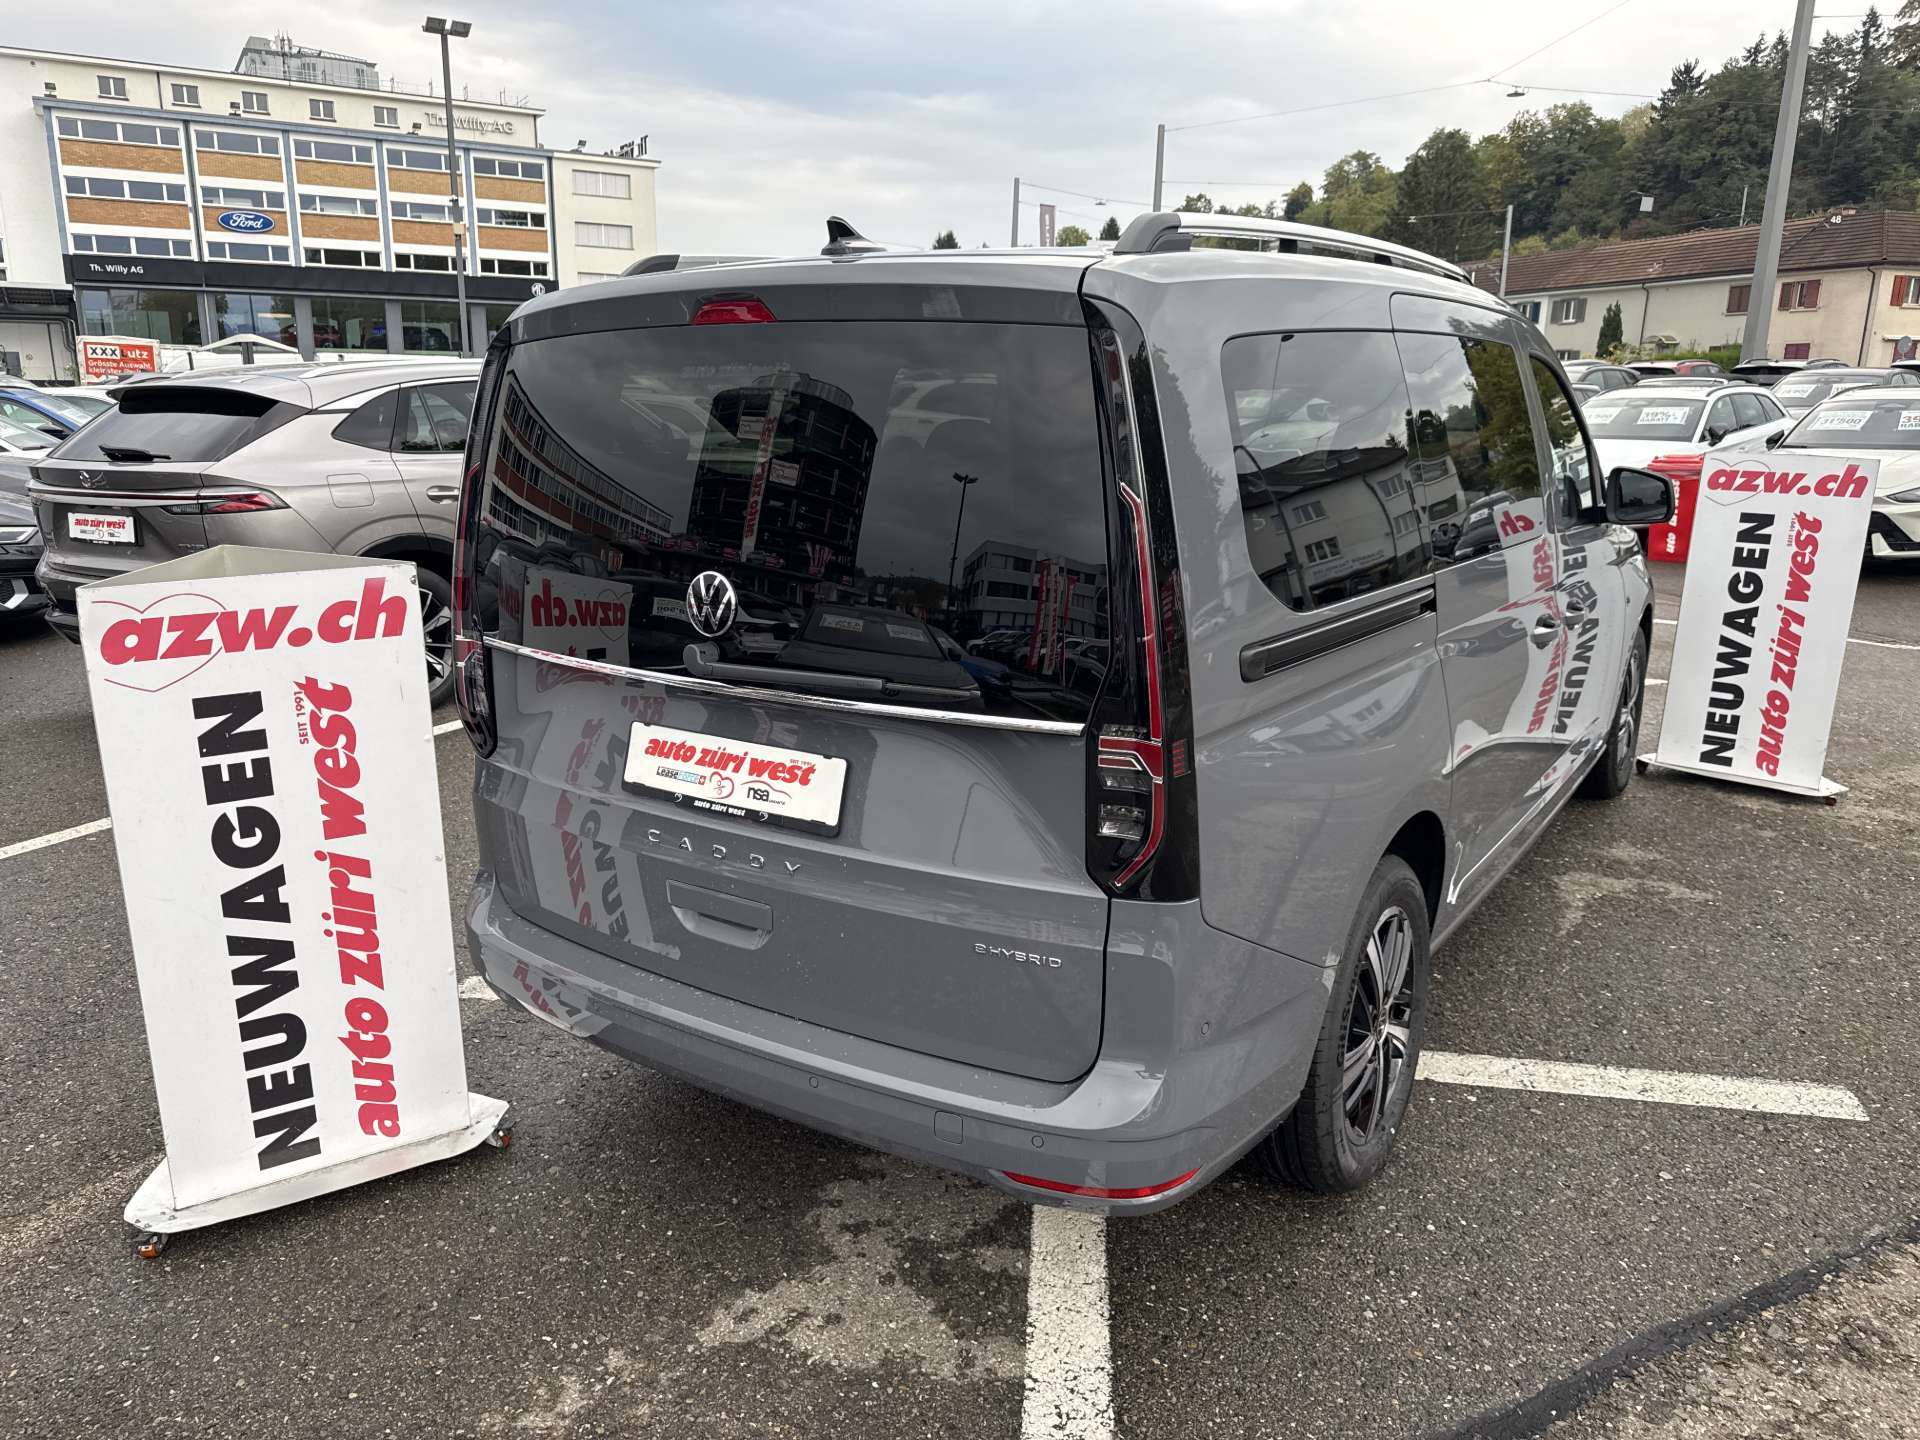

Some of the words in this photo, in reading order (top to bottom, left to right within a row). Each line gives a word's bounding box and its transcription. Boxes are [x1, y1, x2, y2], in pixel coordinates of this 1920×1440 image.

[454, 116, 488, 134] Willy
[491, 121, 514, 134] AG
[229, 213, 264, 229] Ford
[1831, 215, 1841, 223] 48
[90, 263, 103, 272] Th.
[106, 264, 128, 275] Willy
[130, 266, 144, 274] AG
[1707, 464, 1869, 498] azw.ch
[106, 520, 126, 529] west
[1784, 510, 1823, 602] west
[100, 577, 408, 666] azw.ch
[1699, 512, 1775, 767] NEUWAGEN
[1769, 604, 1806, 691] züri
[293, 690, 306, 717] 1991
[297, 721, 309, 744] SEIT
[1756, 690, 1790, 777] auto
[292, 676, 368, 840] west
[644, 738, 696, 763] auto
[695, 746, 748, 774] züri
[748, 756, 817, 786] west
[694, 800, 710, 809] auto
[728, 807, 746, 816] west
[746, 786, 770, 802] nsa
[647, 828, 801, 877] CADDY
[192, 690, 321, 1171] NEUWAGEN
[314, 849, 385, 991] züri
[337, 997, 401, 1138] auto
